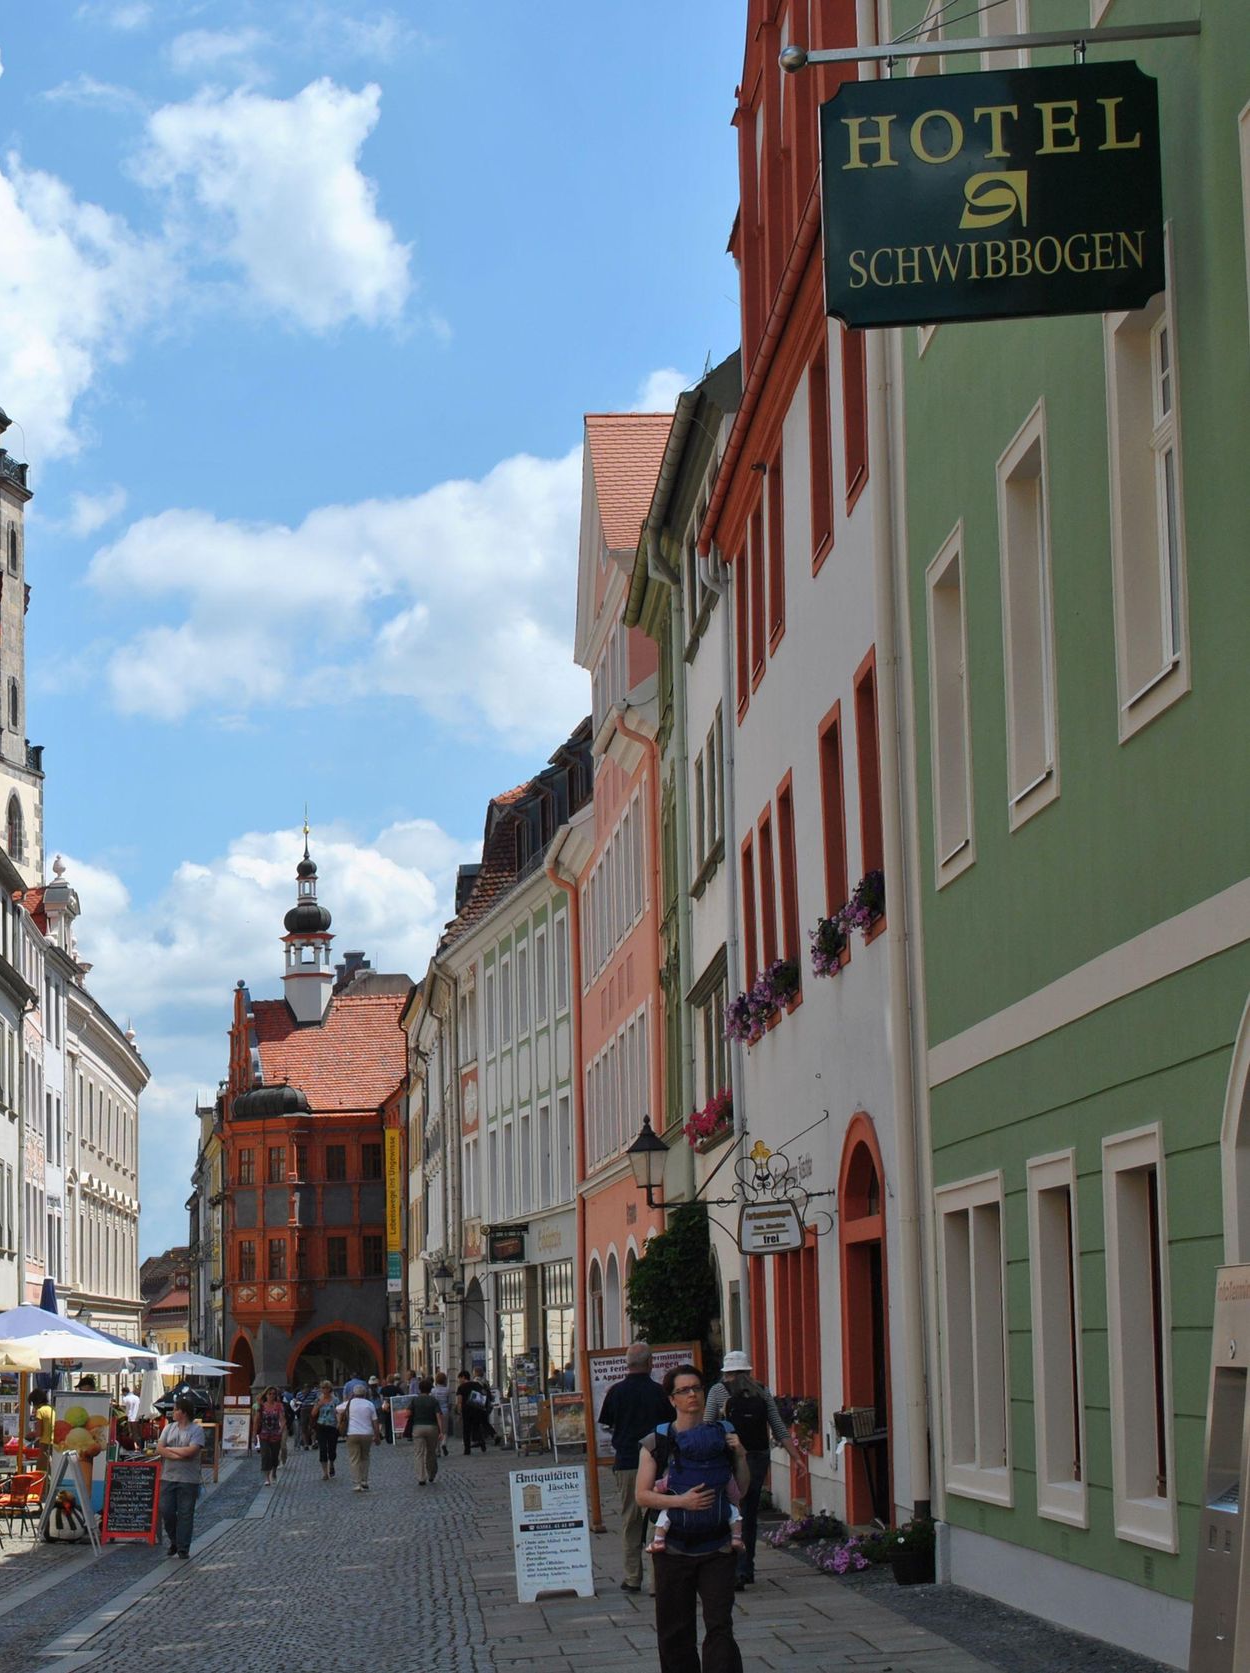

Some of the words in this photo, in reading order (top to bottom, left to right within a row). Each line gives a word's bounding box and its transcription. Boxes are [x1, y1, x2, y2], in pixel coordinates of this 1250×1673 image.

[840, 97, 1141, 170] HOTEL
[849, 231, 1145, 288] SCHWIBBOGEN
[389, 1136, 397, 1178] Ungewisse
[389, 1193, 397, 1235] Lebenswege
[763, 1234, 779, 1244] frei
[652, 1352, 692, 1361] ermittlung
[515, 1472, 579, 1484] Antiquitäten
[548, 1483, 579, 1491] Jäschke
